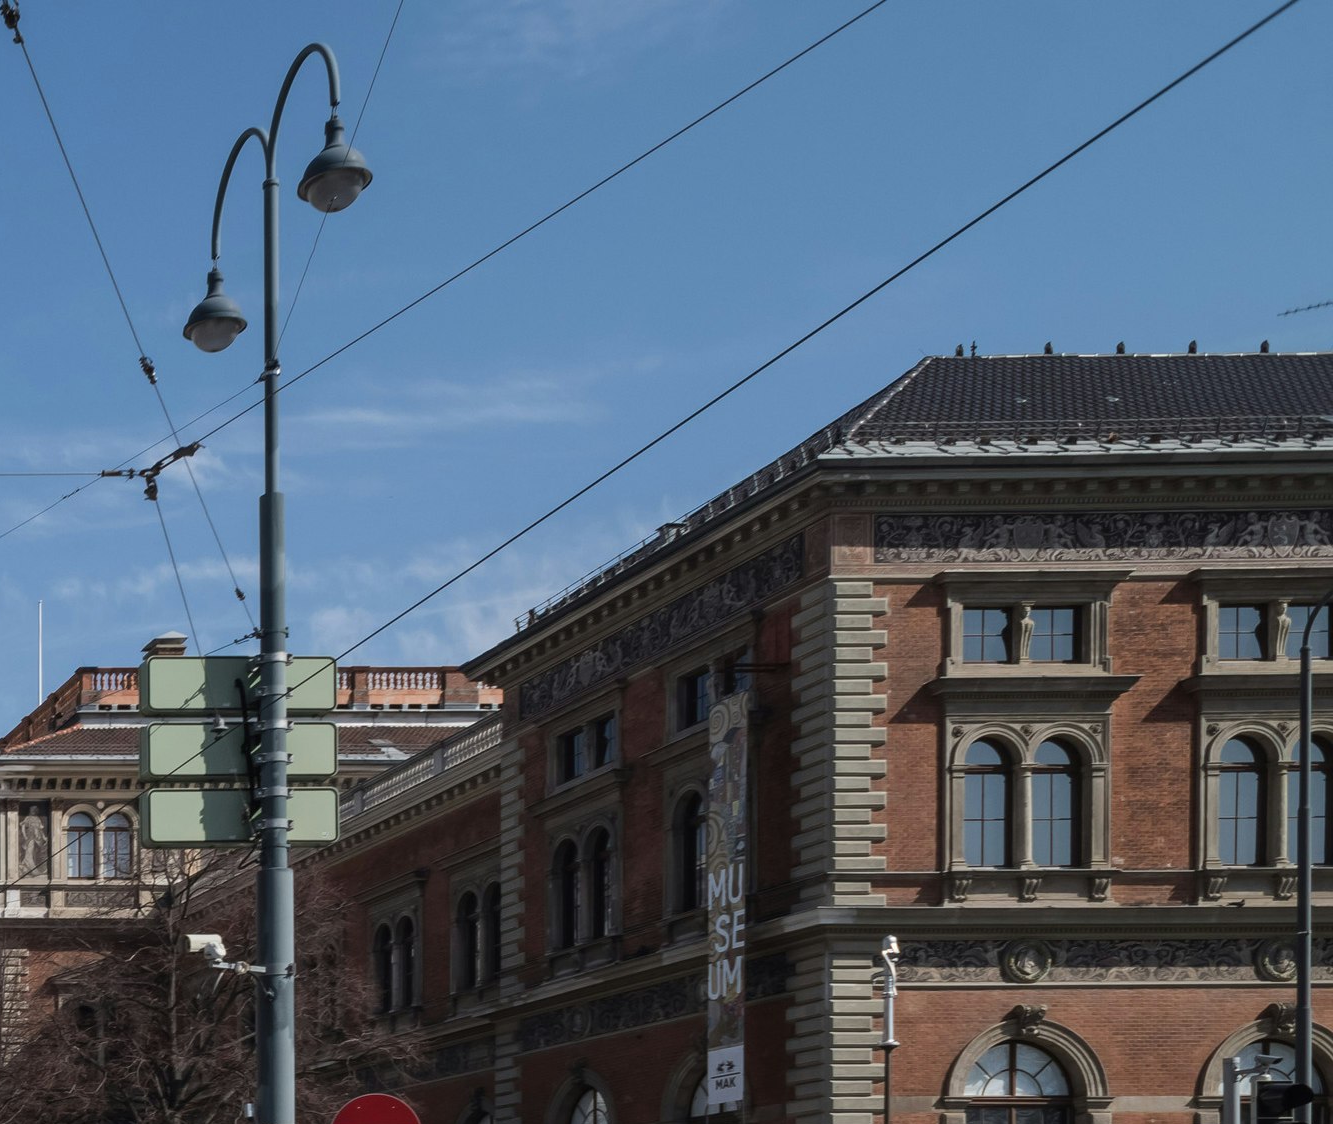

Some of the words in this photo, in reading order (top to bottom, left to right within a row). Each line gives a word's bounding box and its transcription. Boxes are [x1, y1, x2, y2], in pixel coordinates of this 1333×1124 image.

[708, 862, 744, 911] MU
[714, 909, 746, 953] SE
[708, 955, 743, 1001] UM
[715, 1076, 737, 1090] MAK
